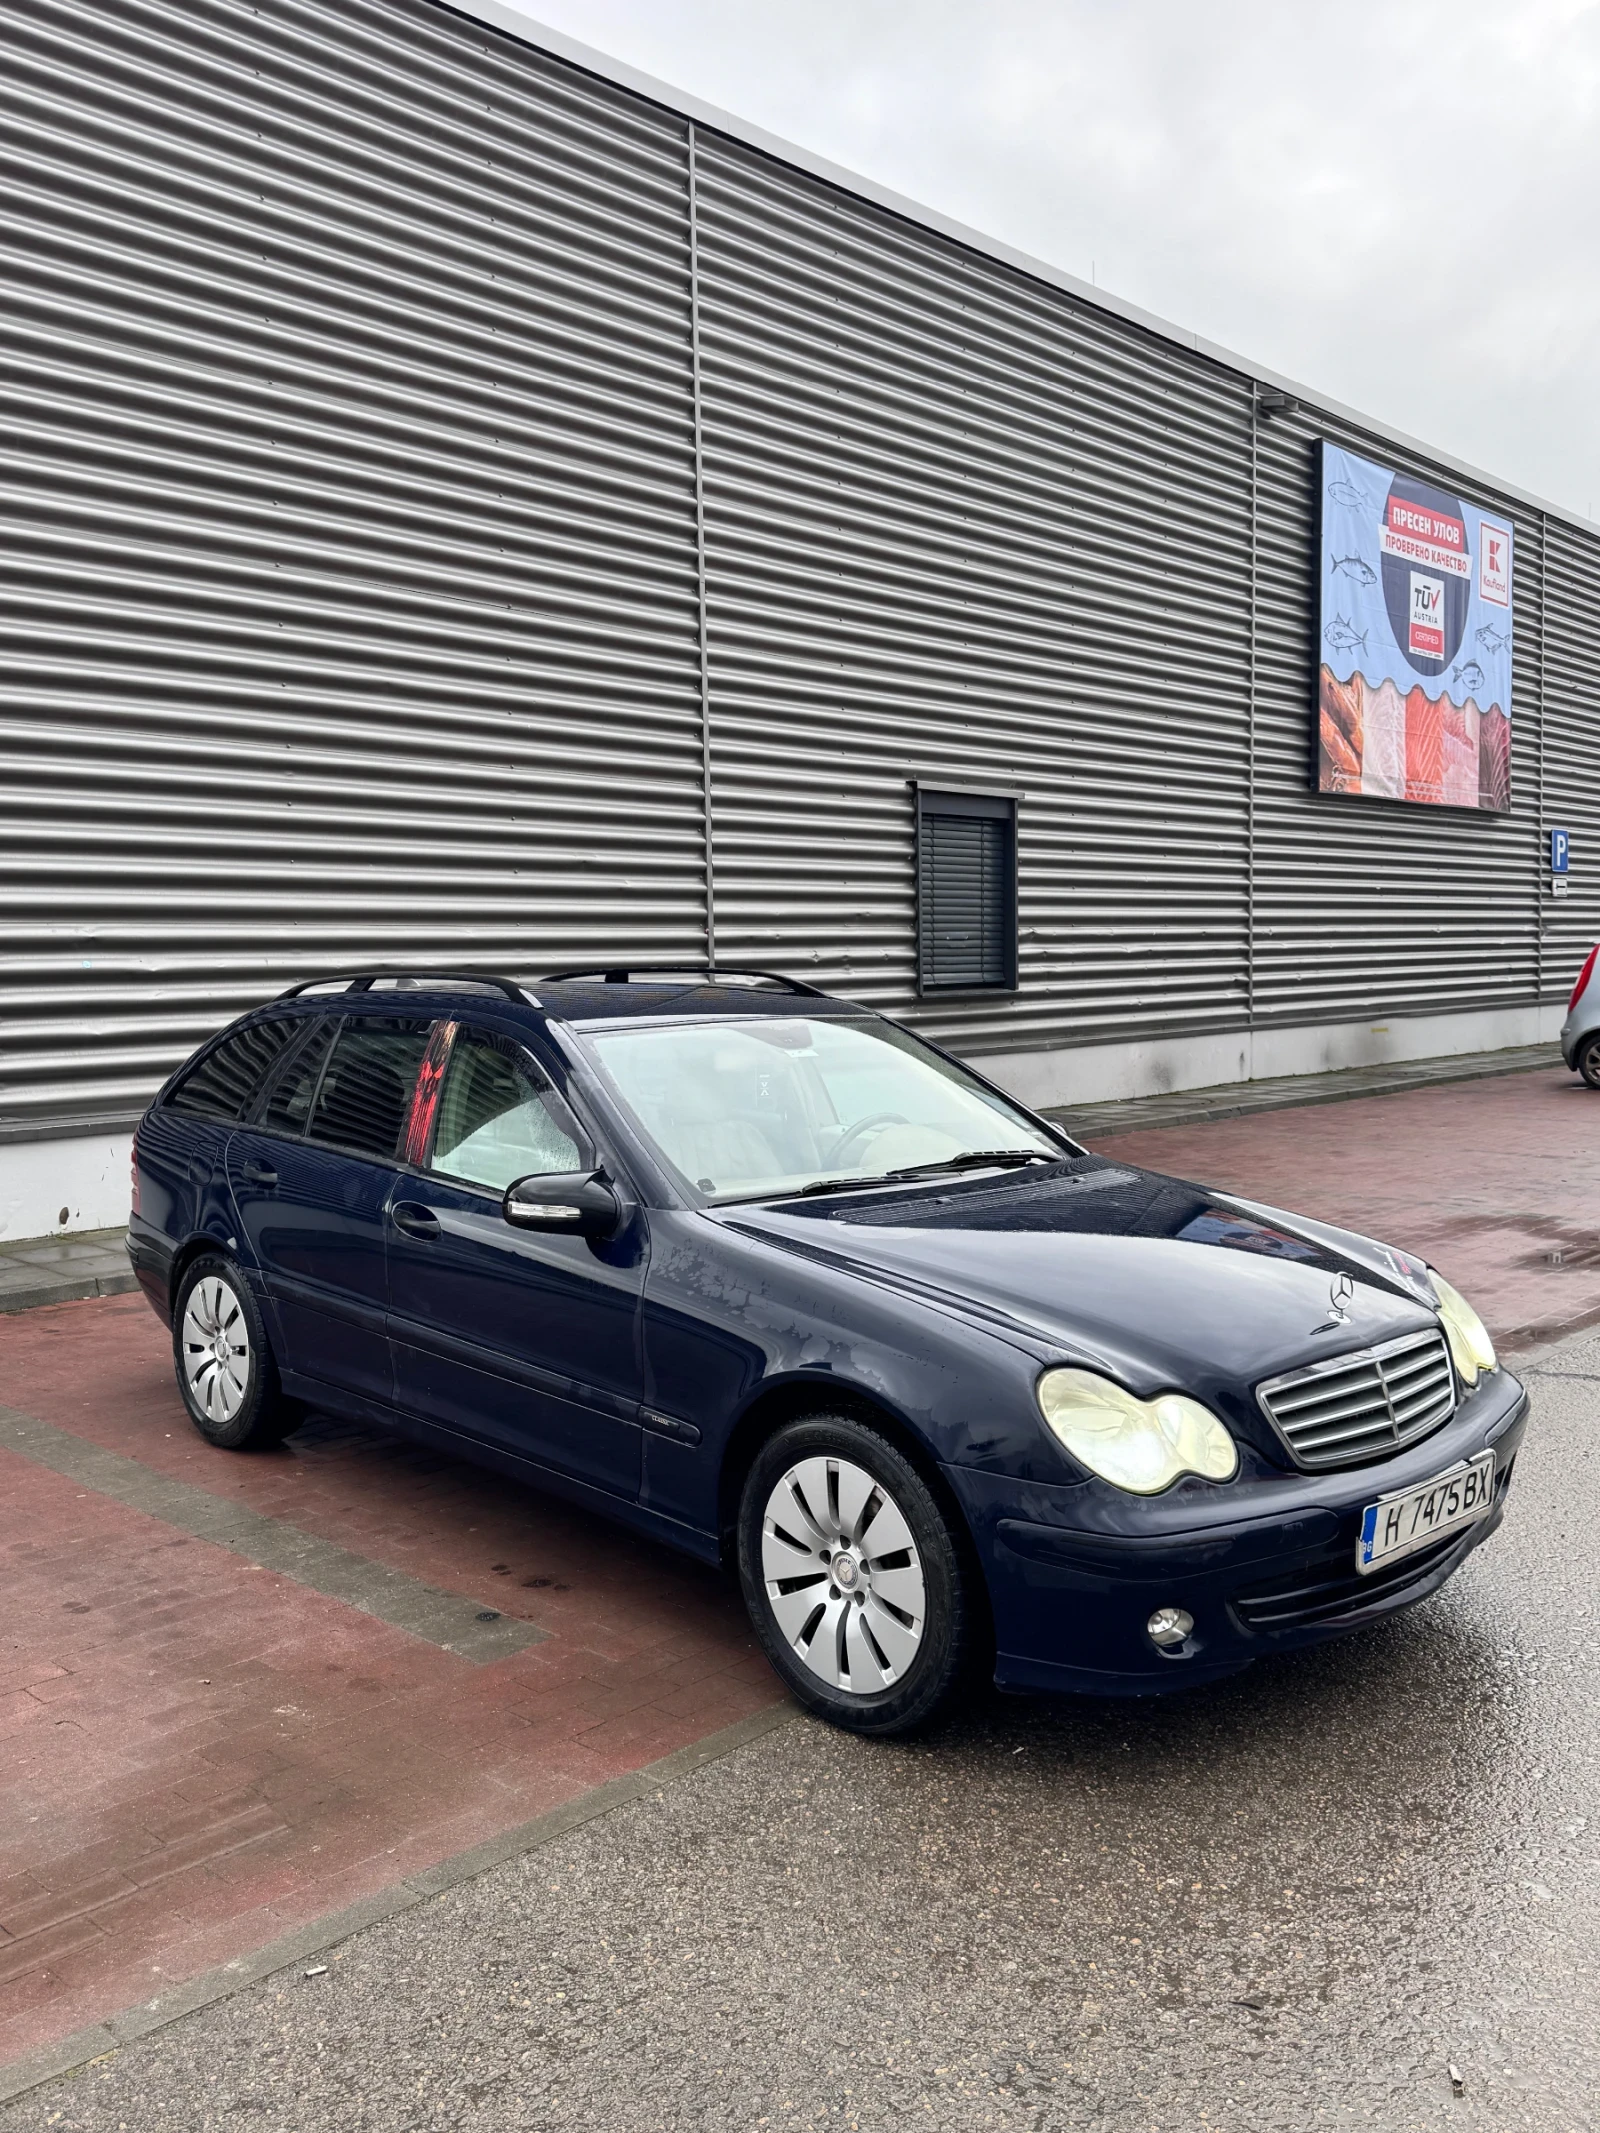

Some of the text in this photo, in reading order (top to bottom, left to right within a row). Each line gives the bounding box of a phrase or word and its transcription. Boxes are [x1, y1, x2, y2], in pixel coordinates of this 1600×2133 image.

[1393, 507, 1460, 544] ПРЕСЕН УЛОВ
[1385, 534, 1467, 572] ПРОВЕРЕНО КАЧЕСТВО
[1483, 574, 1506, 593] Kaufland
[1413, 611, 1439, 624] AUSTRIA
[1556, 834, 1567, 867] P
[1384, 1463, 1490, 1547] H 7475 BX
